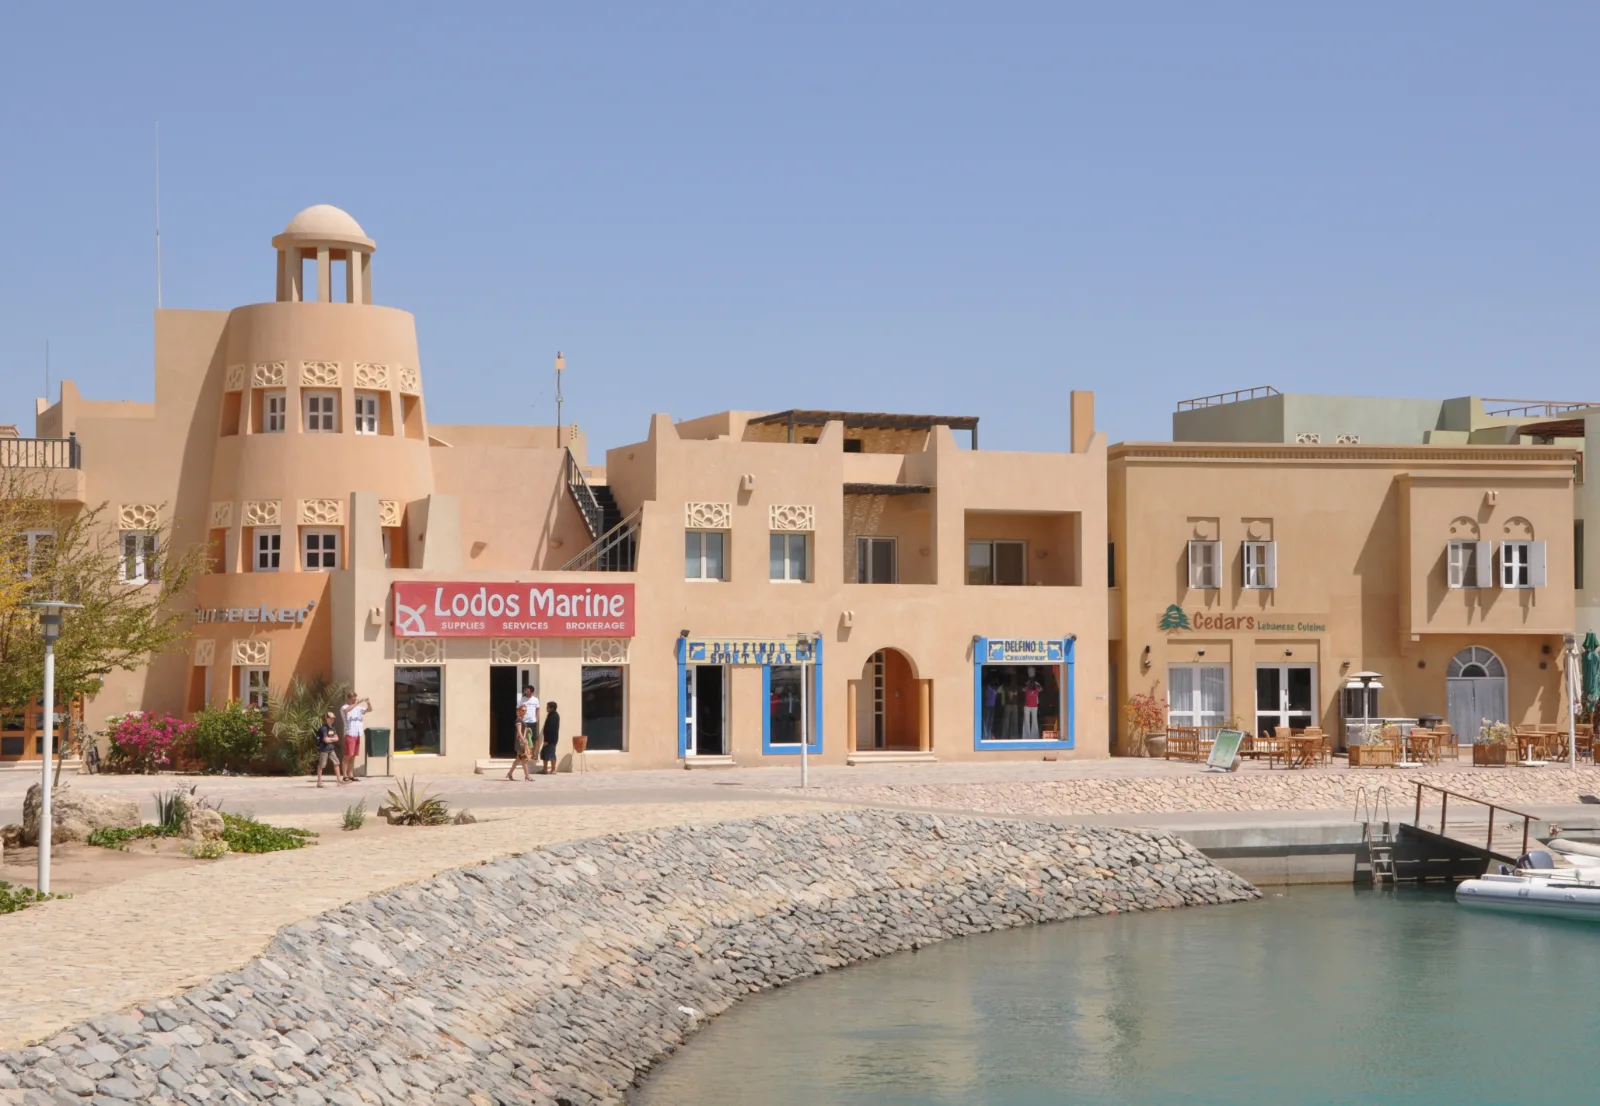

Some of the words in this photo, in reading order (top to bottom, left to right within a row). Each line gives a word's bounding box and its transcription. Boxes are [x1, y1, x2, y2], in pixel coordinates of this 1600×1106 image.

[434, 586, 520, 617] Lodos
[529, 588, 625, 617] Marine
[441, 621, 485, 630] SUPPLIES
[502, 621, 549, 630] SERVICES
[565, 621, 625, 630] BROKERAGE
[1193, 611, 1255, 630] Cedars
[1004, 640, 1036, 653] DELFINO
[710, 653, 750, 664] SPORT
[755, 653, 791, 664] WEAR
